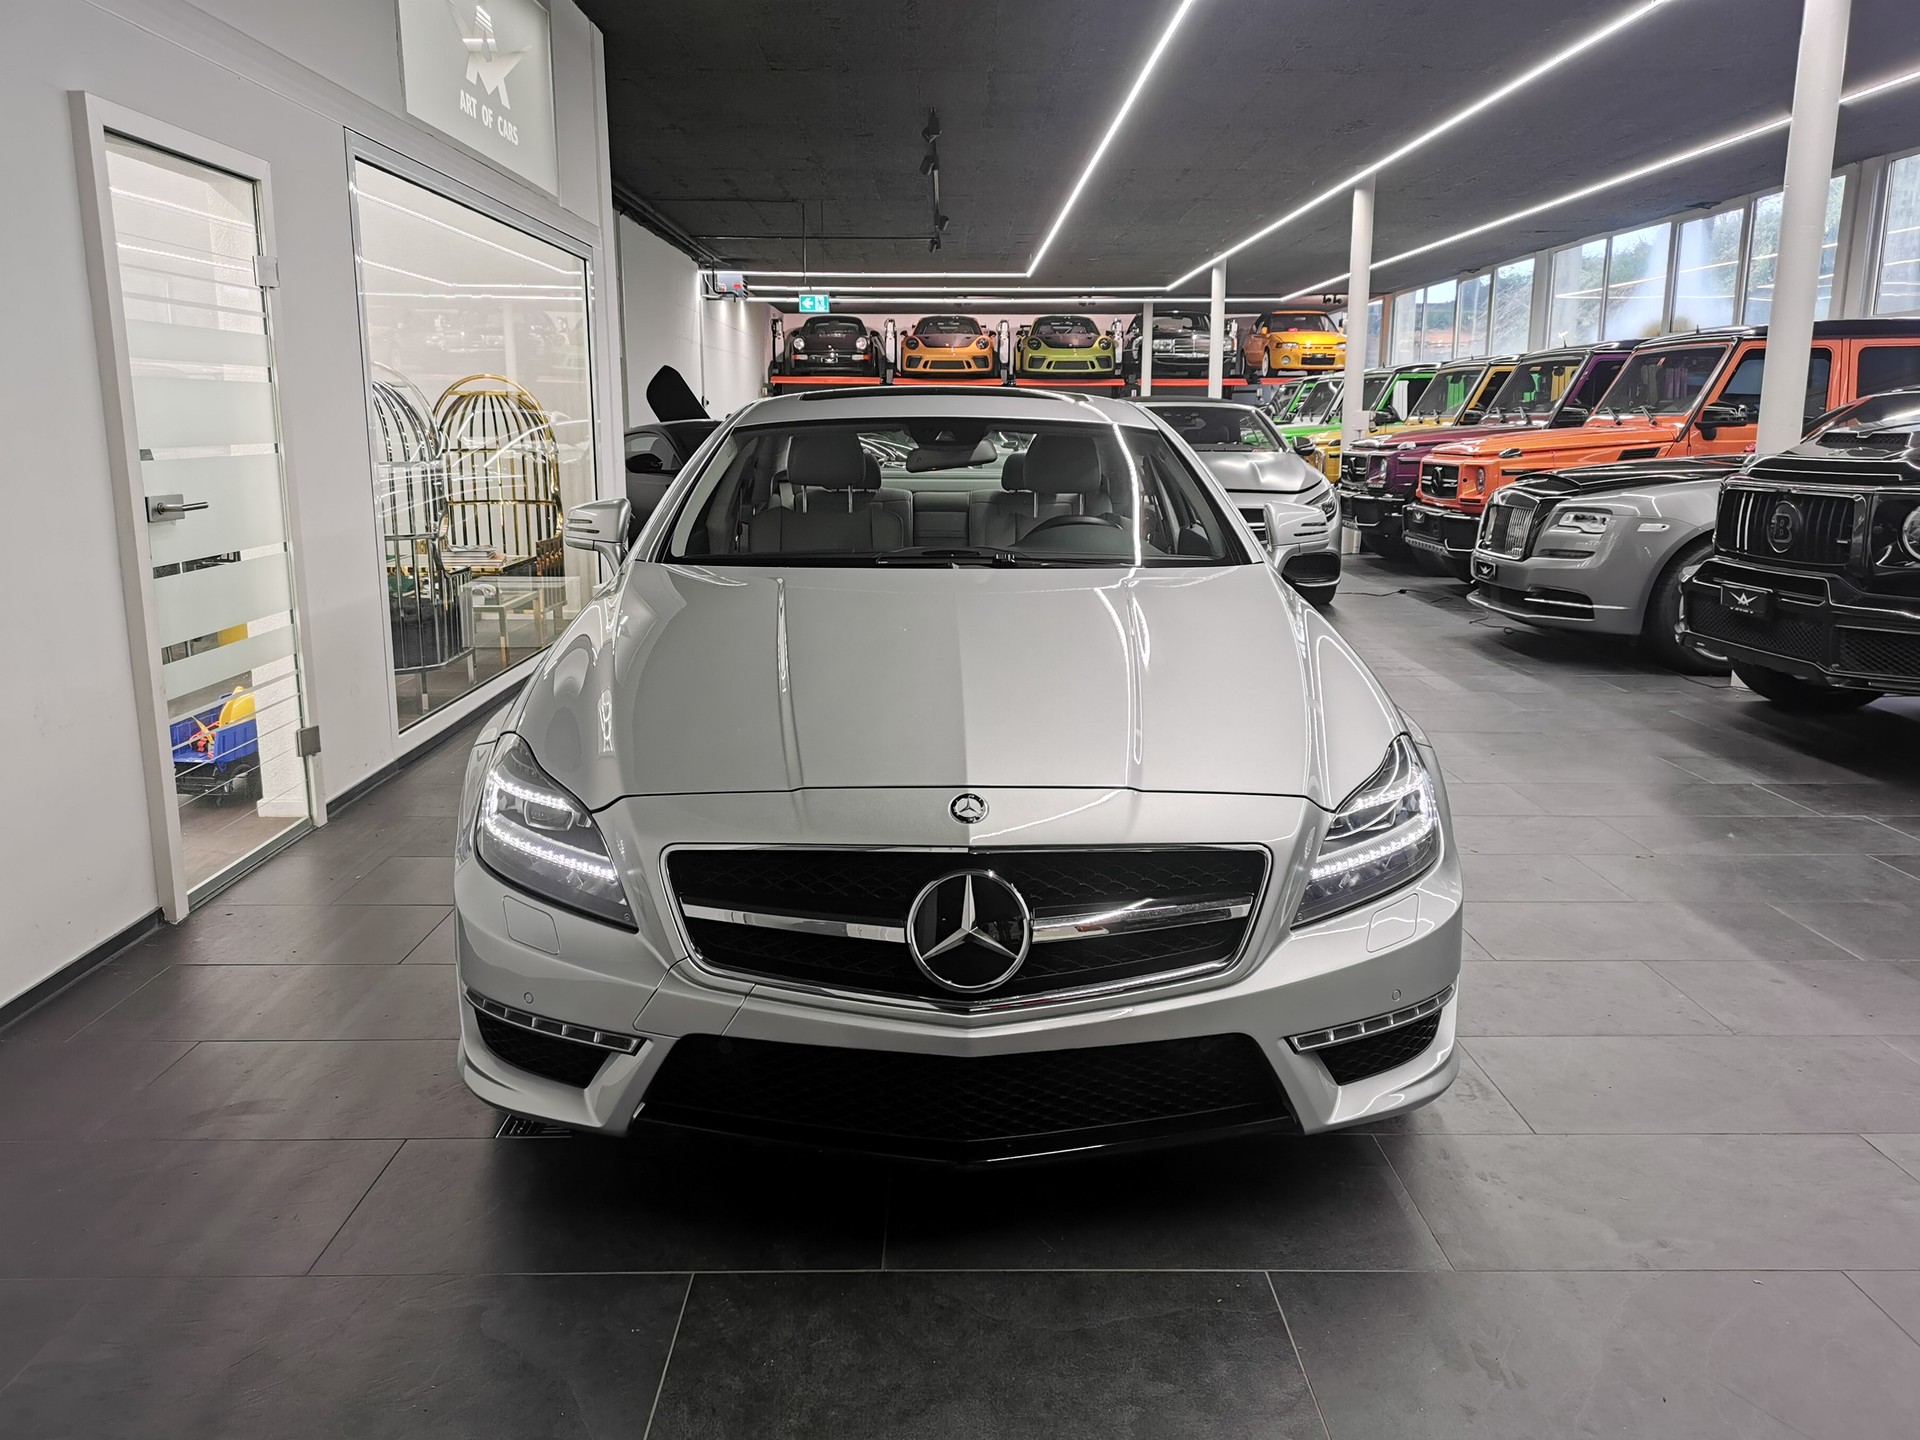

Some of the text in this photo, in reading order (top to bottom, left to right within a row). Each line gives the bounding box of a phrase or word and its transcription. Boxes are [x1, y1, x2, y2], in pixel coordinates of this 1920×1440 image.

[460, 89, 519, 146] ART OF CARS
